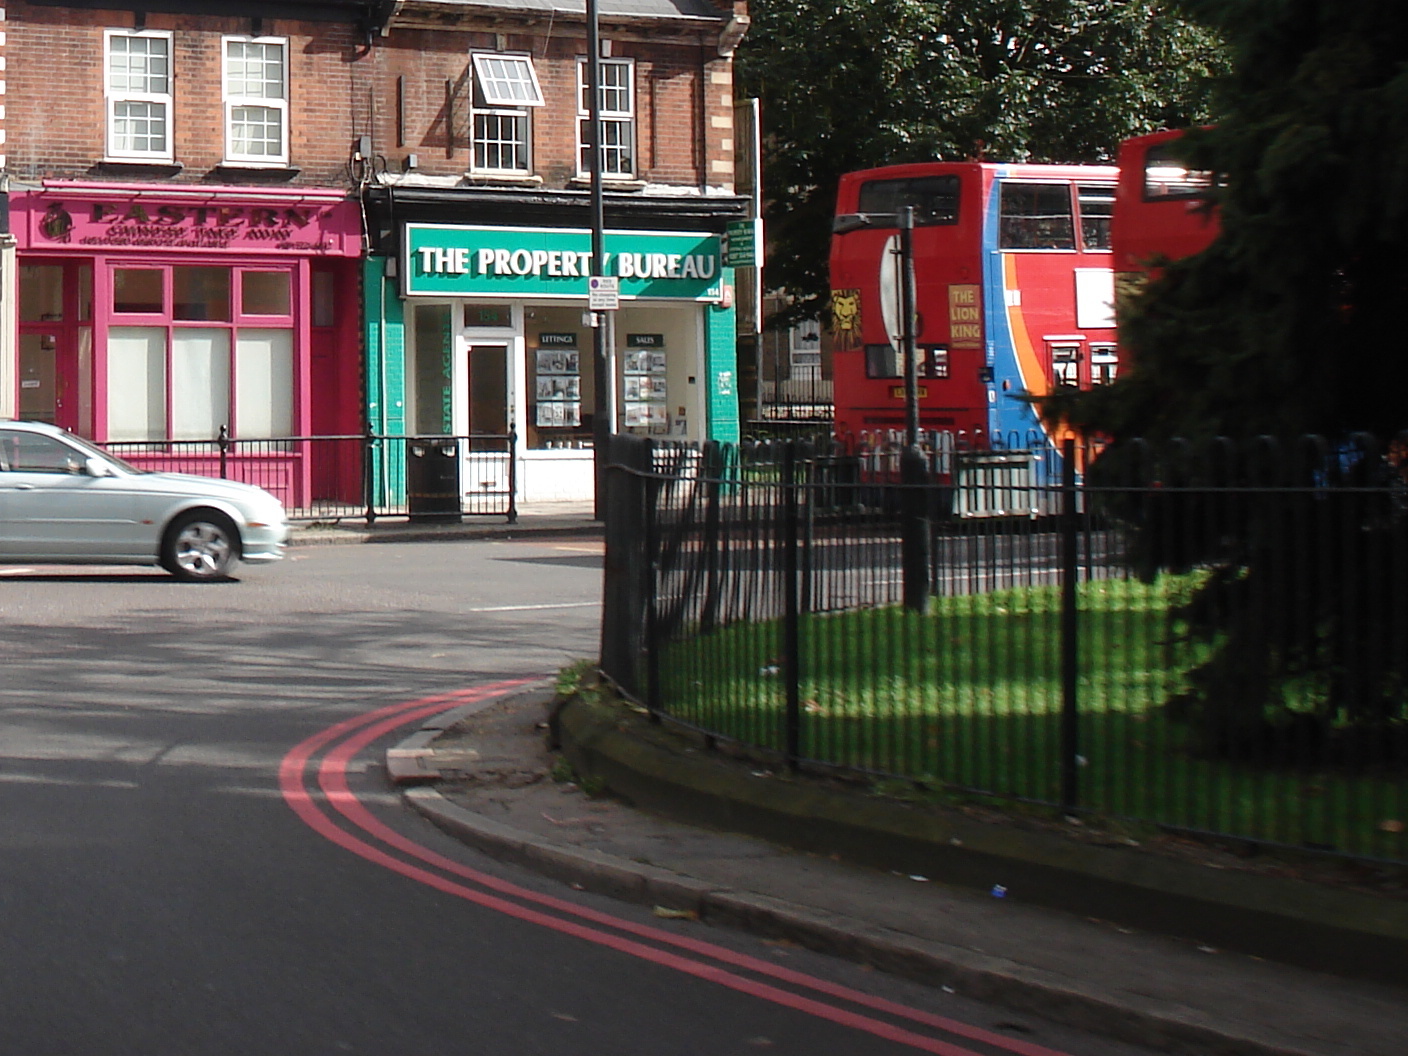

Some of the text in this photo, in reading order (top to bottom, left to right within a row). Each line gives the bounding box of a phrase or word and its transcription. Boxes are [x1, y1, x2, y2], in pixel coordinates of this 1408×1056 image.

[87, 203, 314, 229] EASTERN
[418, 246, 469, 274] THE
[618, 252, 715, 280] BUREAU
[954, 291, 975, 303] THE
[952, 307, 980, 321] LION
[951, 325, 981, 338] KING
[636, 336, 655, 344] SALES
